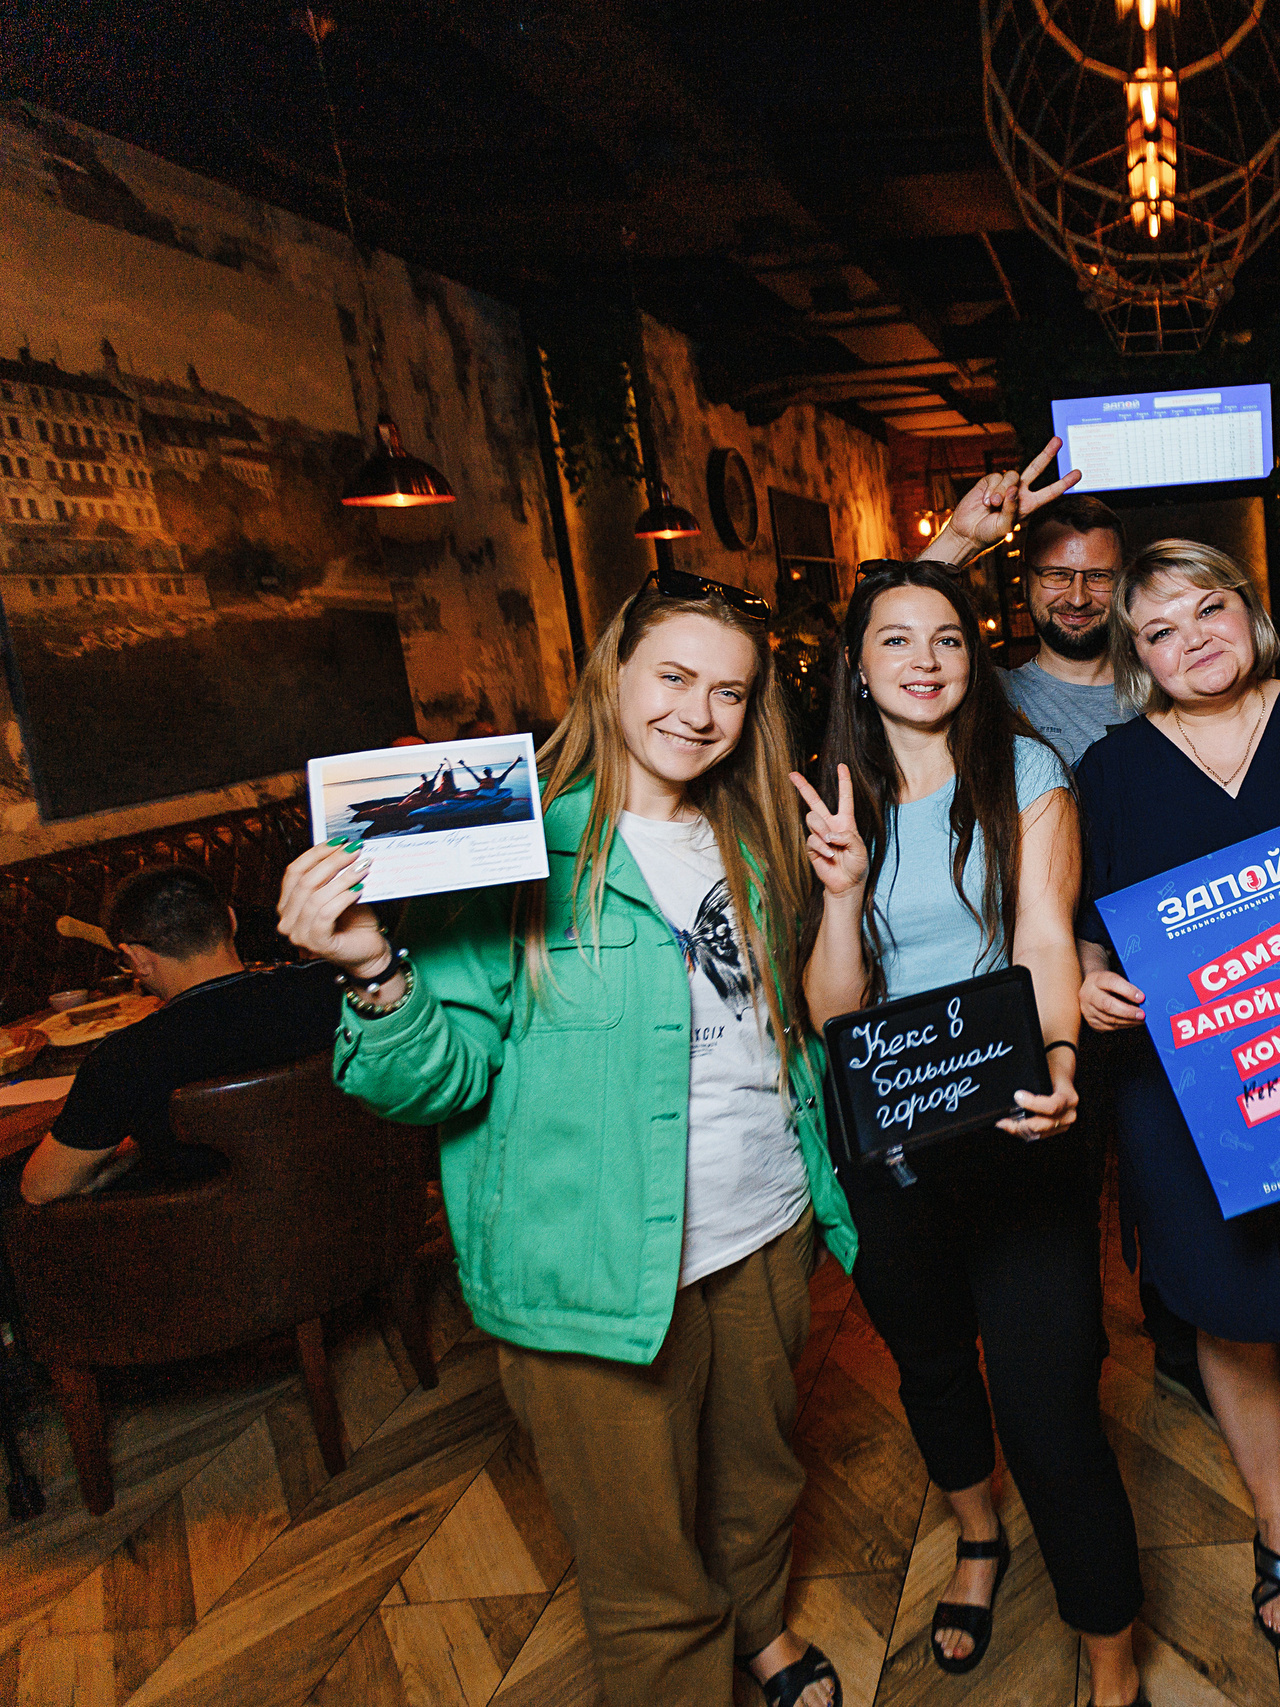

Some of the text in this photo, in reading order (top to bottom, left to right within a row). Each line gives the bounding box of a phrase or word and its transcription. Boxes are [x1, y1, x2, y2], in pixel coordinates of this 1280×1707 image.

[1103, 399, 1140, 410] ЗАПОЙ
[1167, 893, 1275, 940] Вокально-бокальный
[849, 1021, 938, 1069] Кекс
[872, 1041, 1014, 1096] большом
[876, 1076, 980, 1130] городе
